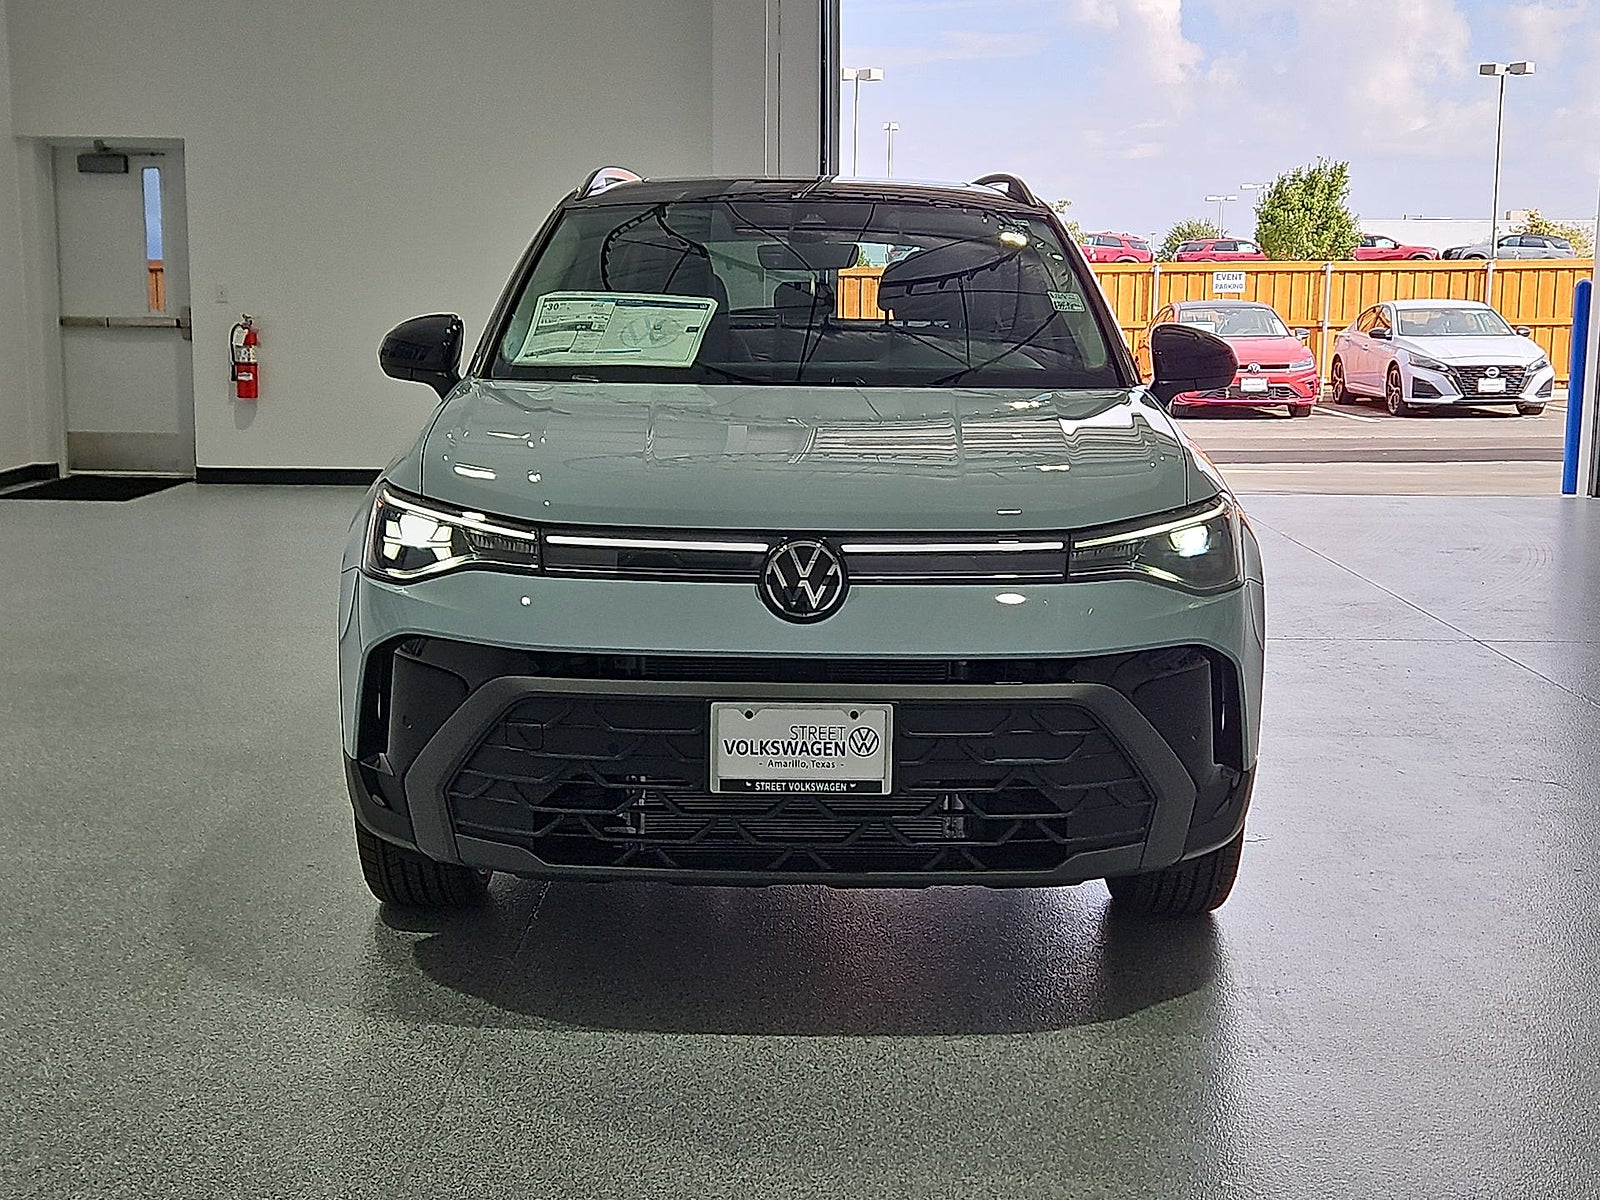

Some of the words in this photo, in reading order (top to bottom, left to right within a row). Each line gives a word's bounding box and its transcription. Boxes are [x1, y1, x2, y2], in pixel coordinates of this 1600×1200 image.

[1216, 273, 1243, 281] EVENT
[790, 725, 846, 741] STREET
[723, 739, 846, 756] VOLKSWAGEN
[767, 759, 809, 769] Amarillo,
[811, 759, 836, 769] Texas
[755, 781, 787, 791] STREET
[788, 781, 847, 791] VOLKSWAGEN
